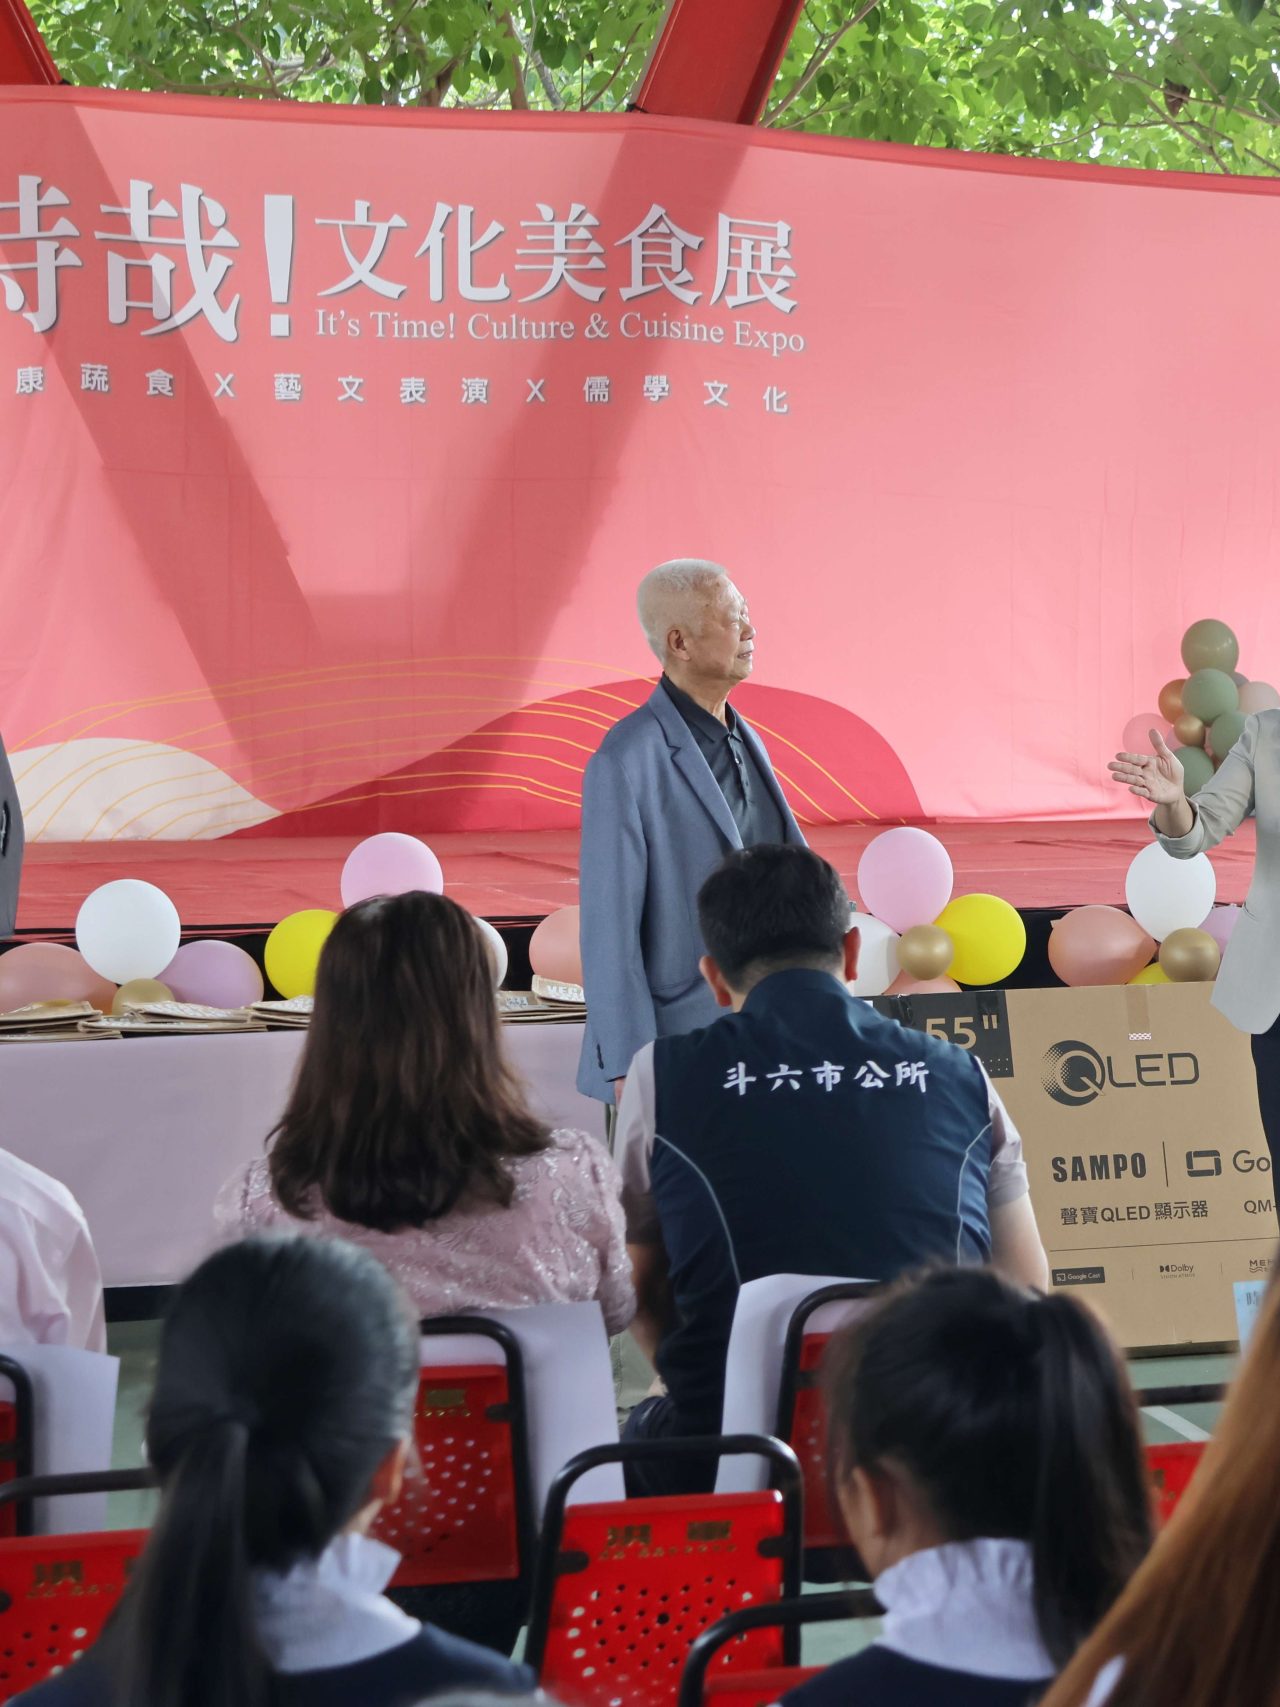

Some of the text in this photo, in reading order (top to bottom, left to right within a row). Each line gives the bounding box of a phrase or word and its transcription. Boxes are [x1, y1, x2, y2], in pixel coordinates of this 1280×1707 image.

[314, 198, 800, 315] 文化美食展
[369, 311, 456, 340] Time!
[467, 313, 575, 340] Culture
[584, 313, 609, 339] &
[619, 312, 726, 345] Cuisine
[733, 320, 807, 358] Expo
[722, 1060, 930, 1096] 斗六市公所
[1041, 1040, 1200, 1107] QLED
[1051, 1152, 1147, 1183] SAMPO
[1170, 1263, 1194, 1273] Dolby
